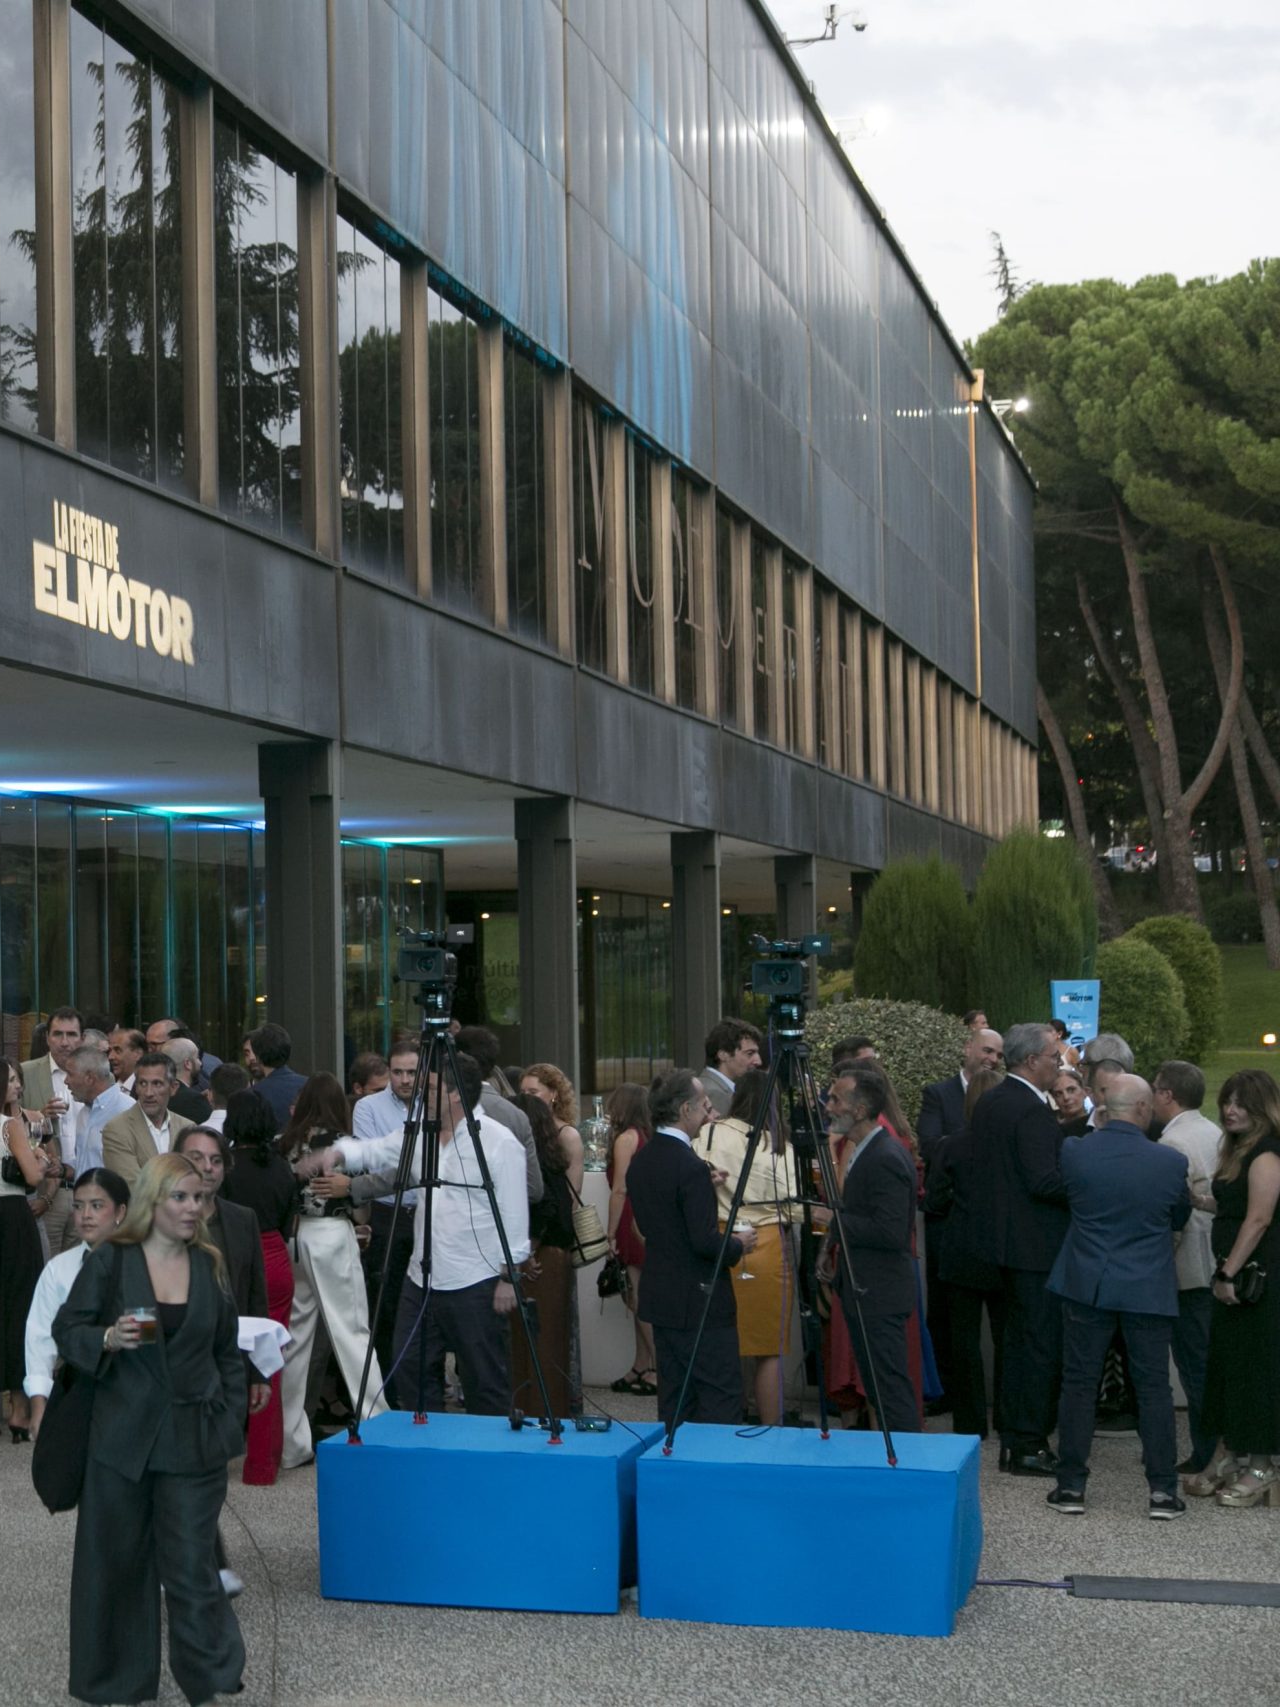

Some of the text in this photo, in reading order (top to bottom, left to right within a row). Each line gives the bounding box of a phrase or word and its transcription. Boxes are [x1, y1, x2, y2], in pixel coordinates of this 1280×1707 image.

[53, 498, 120, 573] LA FIESTA DE
[33, 540, 195, 667] EL MOTOR
